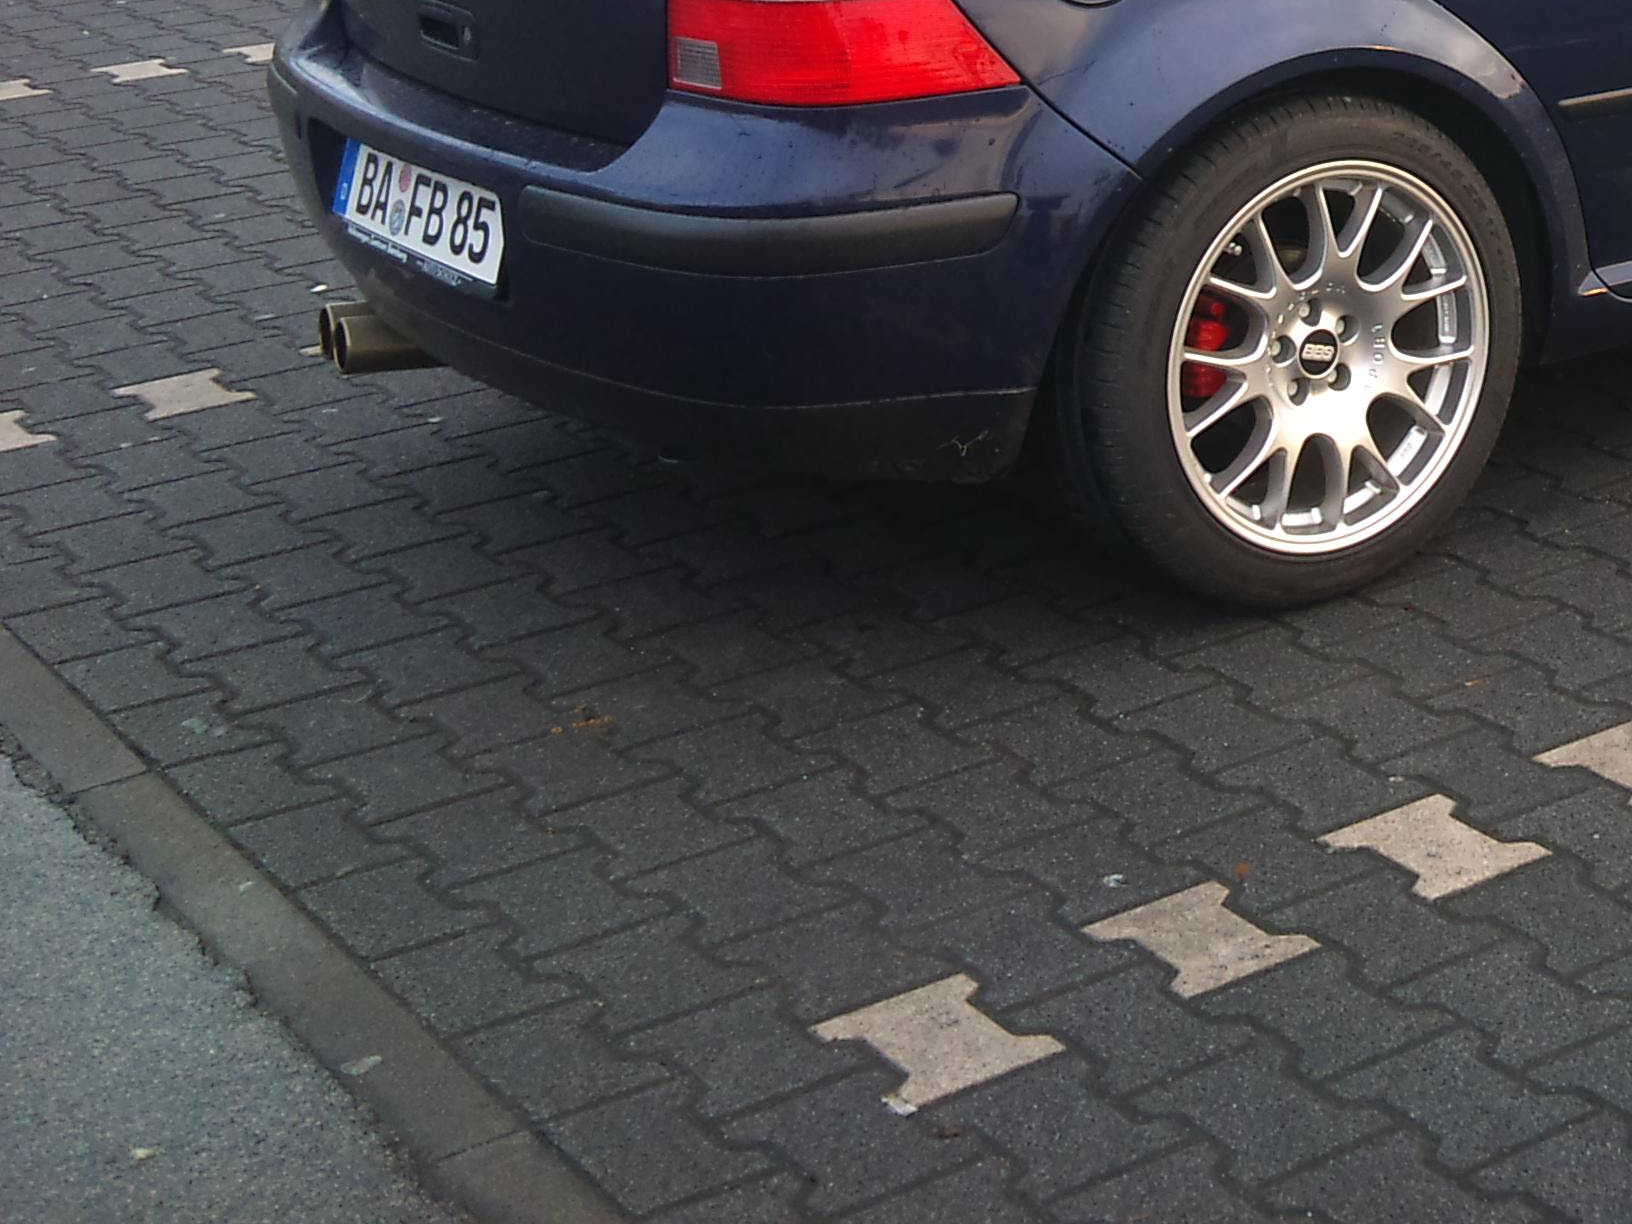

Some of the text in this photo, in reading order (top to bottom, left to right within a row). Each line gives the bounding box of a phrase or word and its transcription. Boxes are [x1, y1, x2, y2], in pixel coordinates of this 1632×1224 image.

[355, 152, 393, 225] BA
[404, 173, 448, 246] FB
[450, 190, 496, 264] 85
[1301, 343, 1335, 362] BBS
